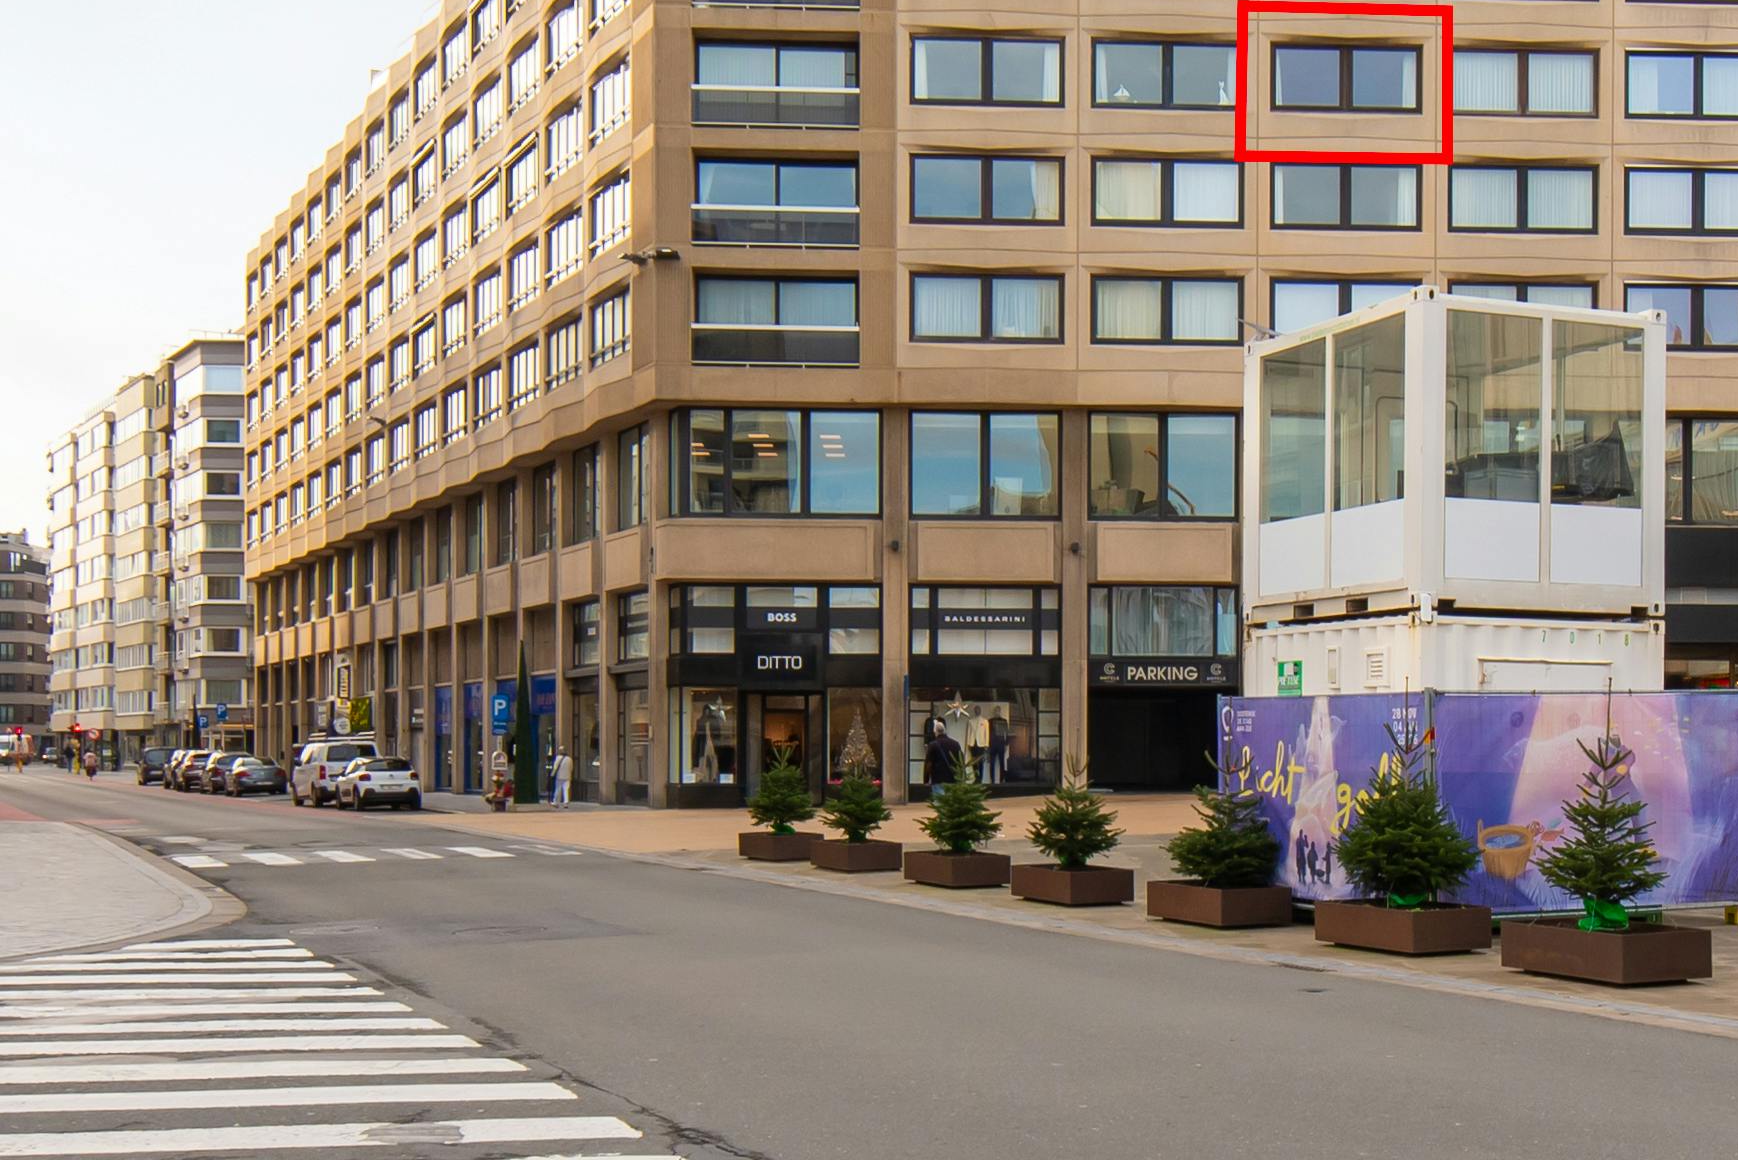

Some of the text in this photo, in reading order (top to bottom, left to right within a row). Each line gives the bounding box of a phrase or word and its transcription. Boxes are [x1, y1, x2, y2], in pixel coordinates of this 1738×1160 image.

[767, 612, 797, 622] BOSS
[944, 615, 1026, 623] BALDESSARINI
[757, 655, 803, 670] DITTO
[1127, 666, 1199, 681] PARKING
[494, 699, 507, 716] P
